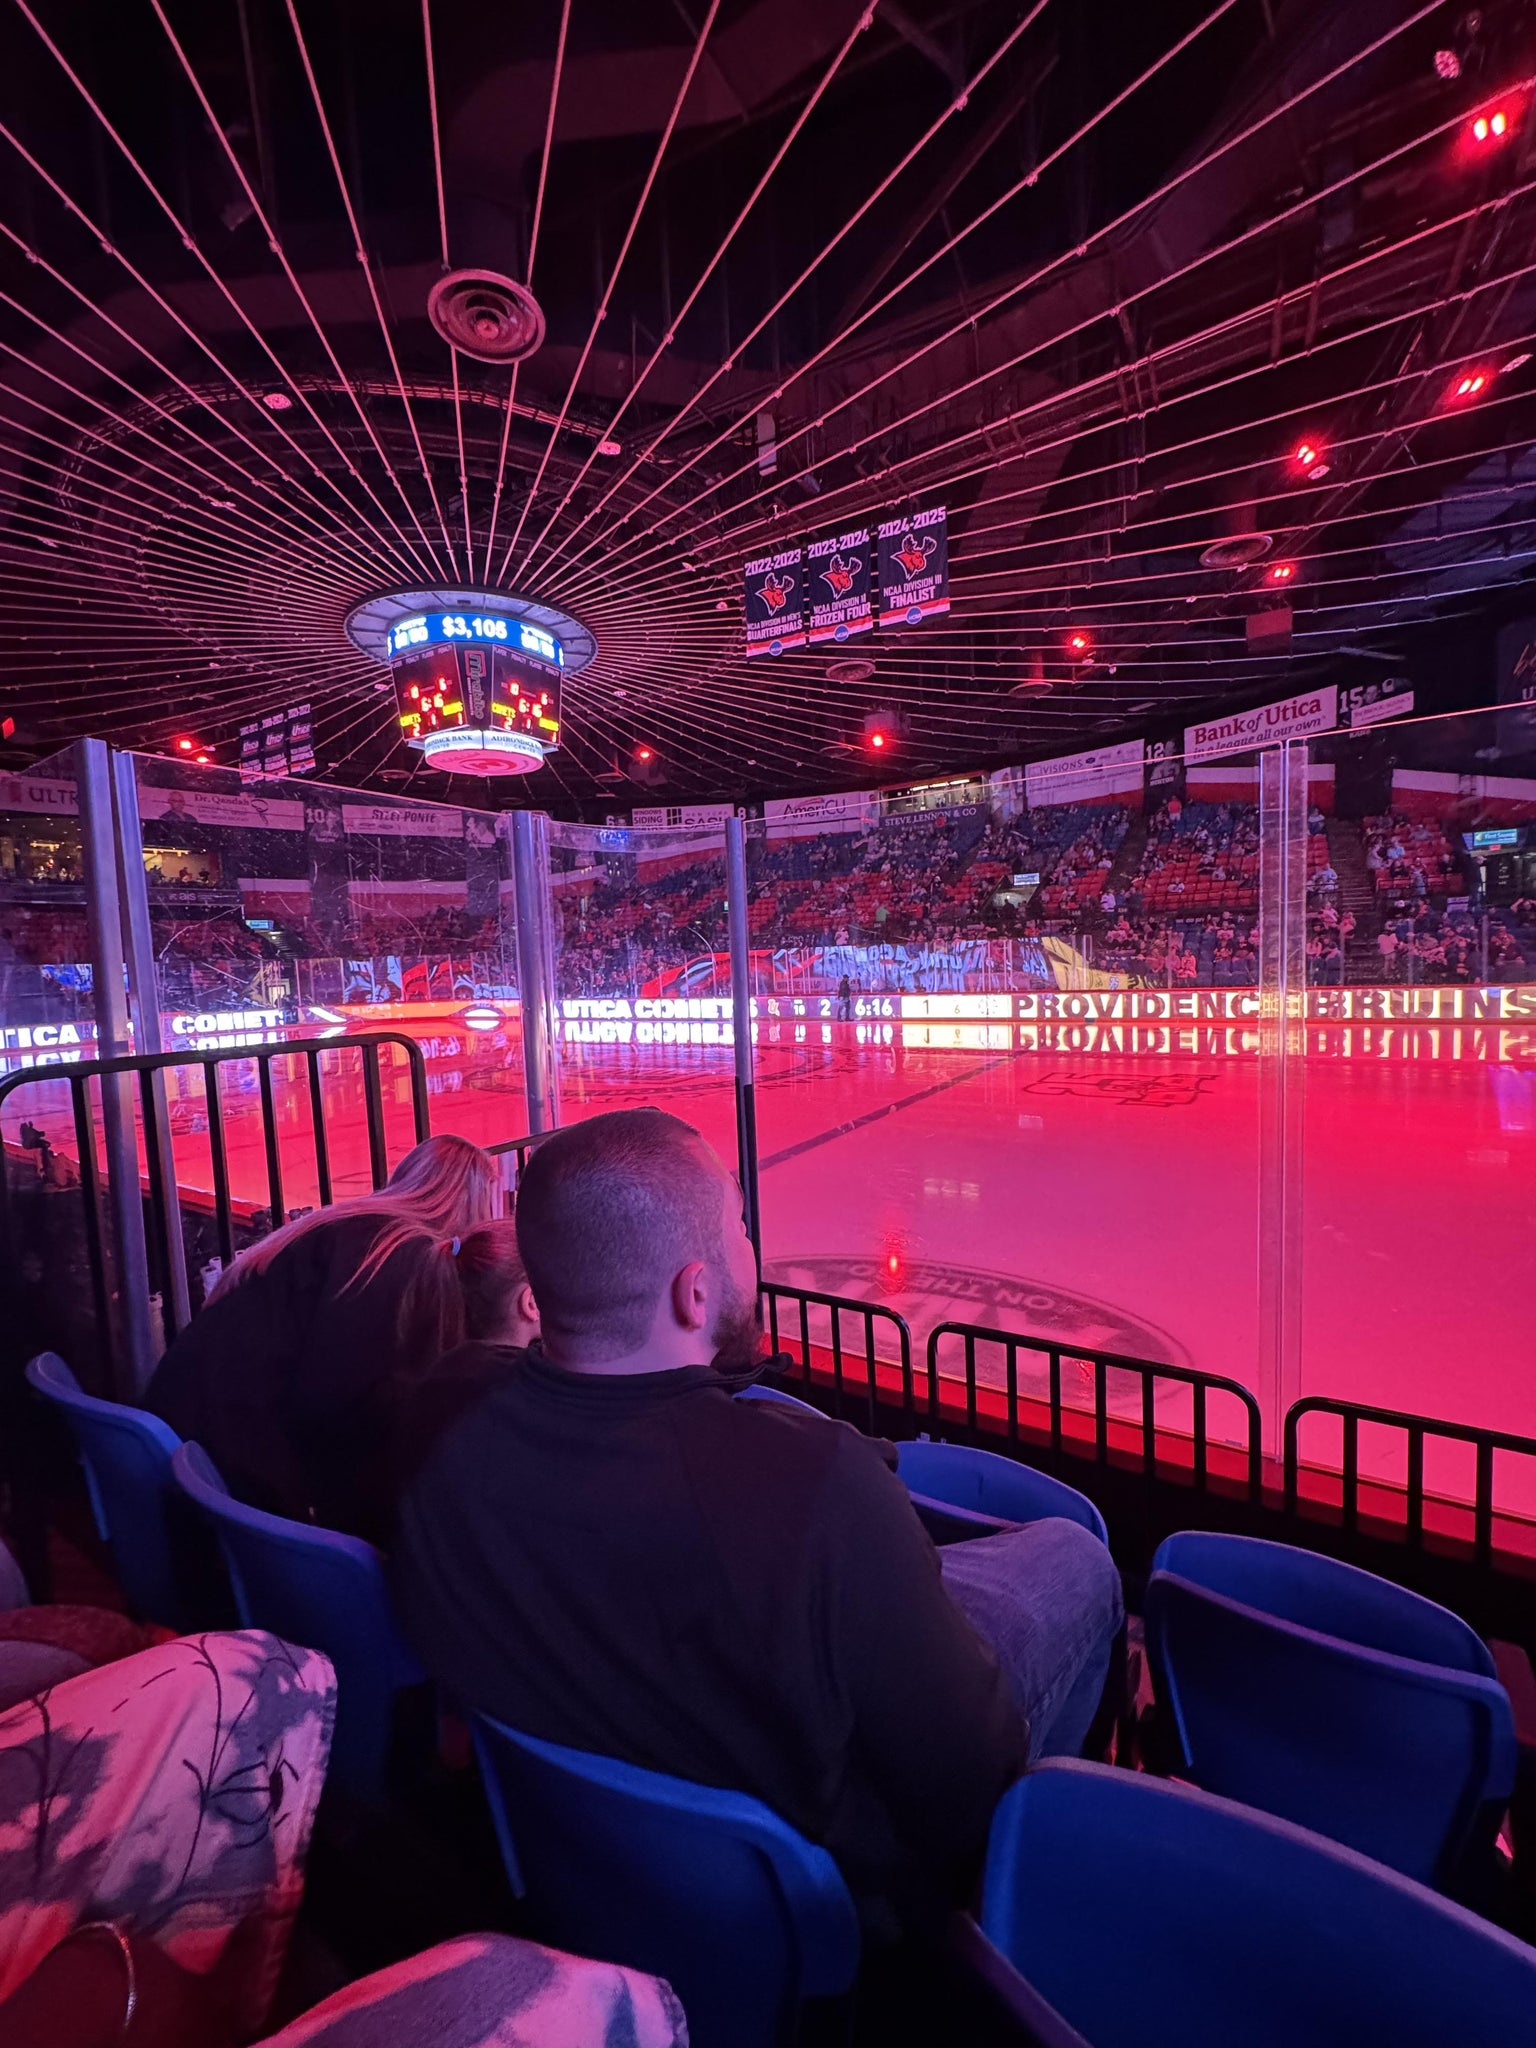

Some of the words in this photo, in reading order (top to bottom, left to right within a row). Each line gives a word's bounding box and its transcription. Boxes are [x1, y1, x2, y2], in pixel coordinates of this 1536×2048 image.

[878, 506, 947, 539] 2024-2025
[808, 529, 870, 559] 2023-2024
[744, 549, 802, 577] 2022-2023
[883, 584, 903, 597] NCAA
[903, 576, 934, 593] DIVISION
[890, 586, 936, 609] FINALIST
[810, 610, 845, 628] FROZEN
[846, 602, 872, 620] FOUR
[813, 604, 831, 614] NCAA
[831, 597, 860, 611] DIVISION
[747, 620, 803, 641] QUARTERFINALS
[1339, 685, 1365, 714] 15
[1193, 718, 1247, 745] Bank
[1247, 713, 1264, 733] of
[1265, 698, 1322, 725] Utica
[1256, 729, 1272, 741] all
[1273, 726, 1294, 740] our
[1295, 718, 1321, 732] own
[1145, 742, 1164, 765] 12
[306, 808, 325, 824] 10
[783, 799, 847, 819] AmeriCU
[885, 816, 912, 827] STEVE
[912, 811, 952, 824] LENNON
[962, 808, 977, 816] CO
[634, 816, 663, 825] SIDING
[685, 817, 724, 829] SAS
[563, 999, 633, 1019] UTICA
[820, 999, 831, 1016] 2
[855, 999, 893, 1016] 6:16
[1306, 989, 1536, 1018] BRUINS
[172, 1009, 285, 1034] COMET
